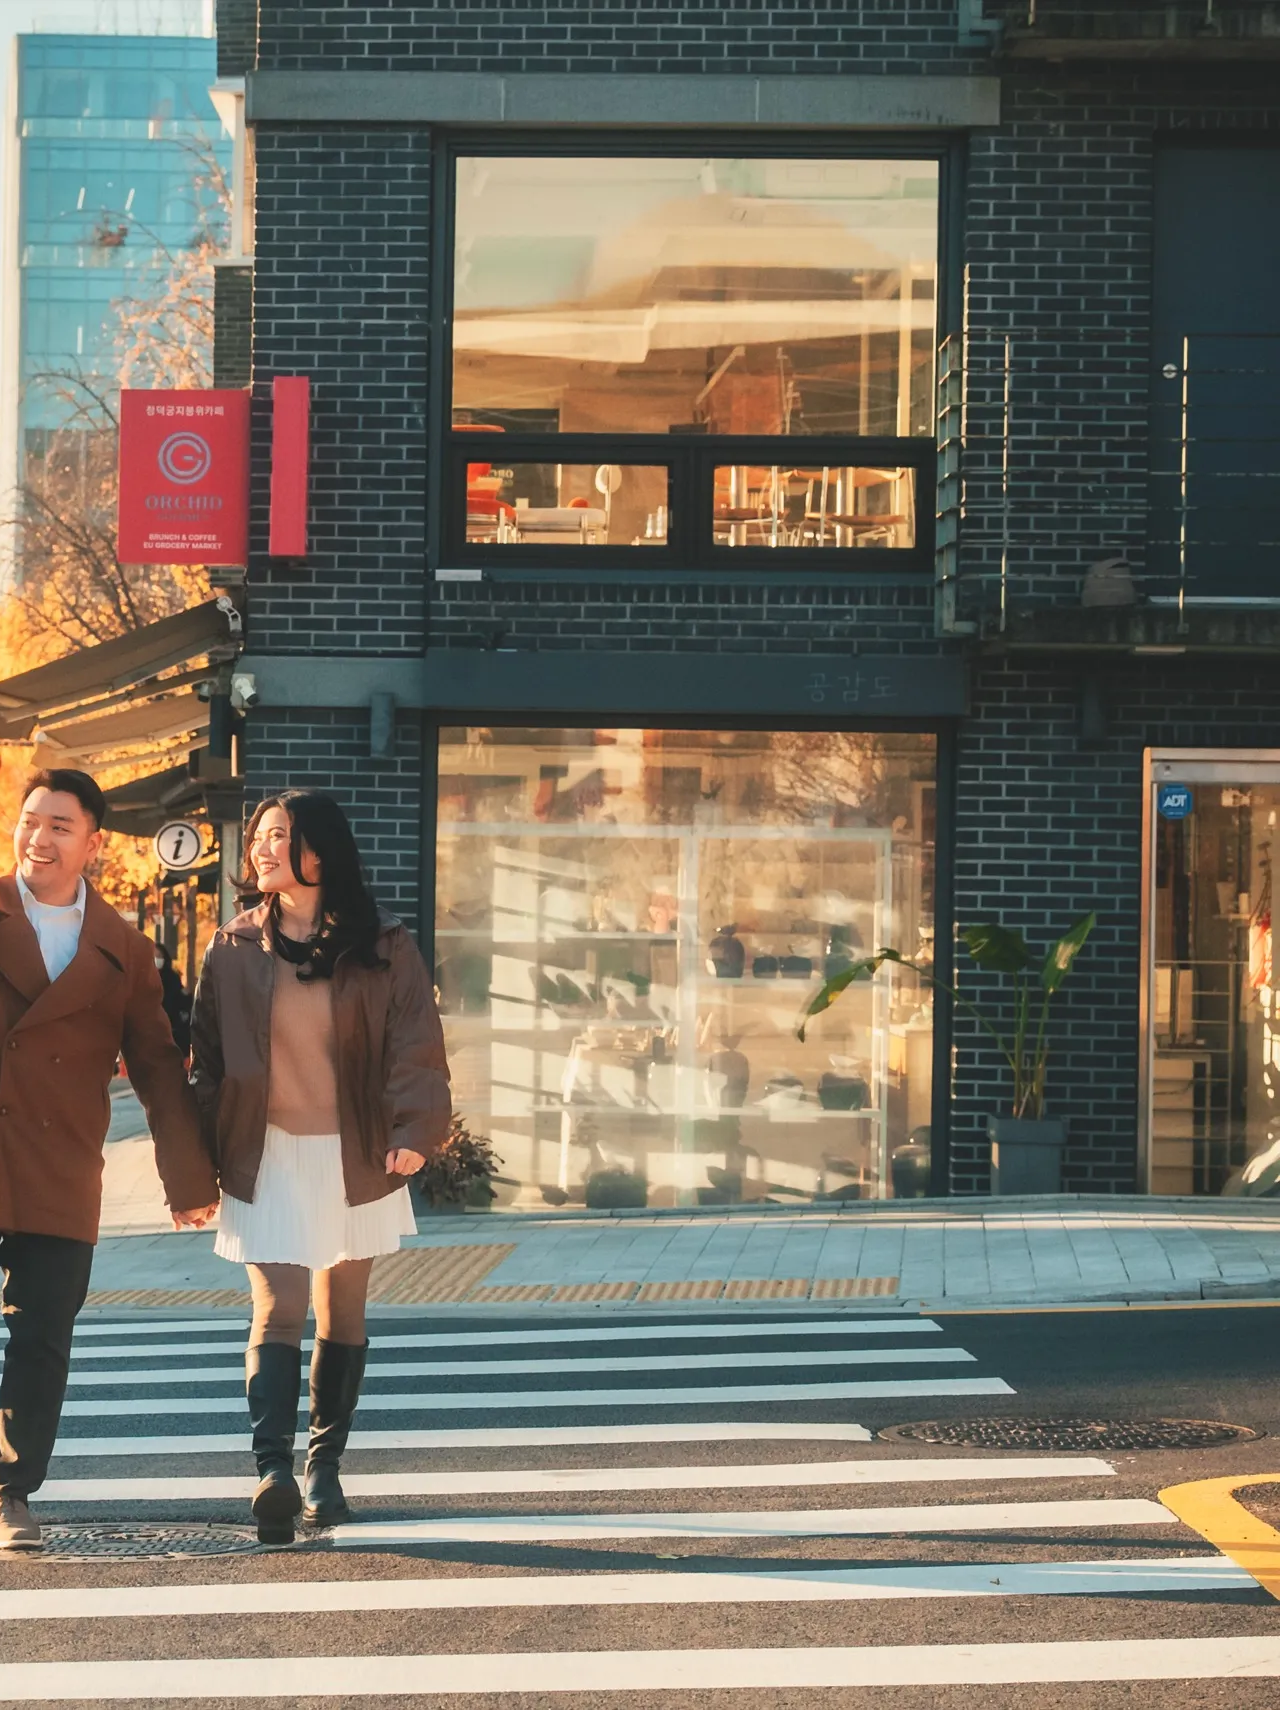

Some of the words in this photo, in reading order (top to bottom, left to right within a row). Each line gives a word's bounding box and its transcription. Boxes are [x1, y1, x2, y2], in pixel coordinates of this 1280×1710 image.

[144, 495, 223, 510] ORCHID
[149, 533, 180, 541] BRUNCH
[192, 542, 222, 550] MARKET
[1163, 795, 1187, 807] ADT
